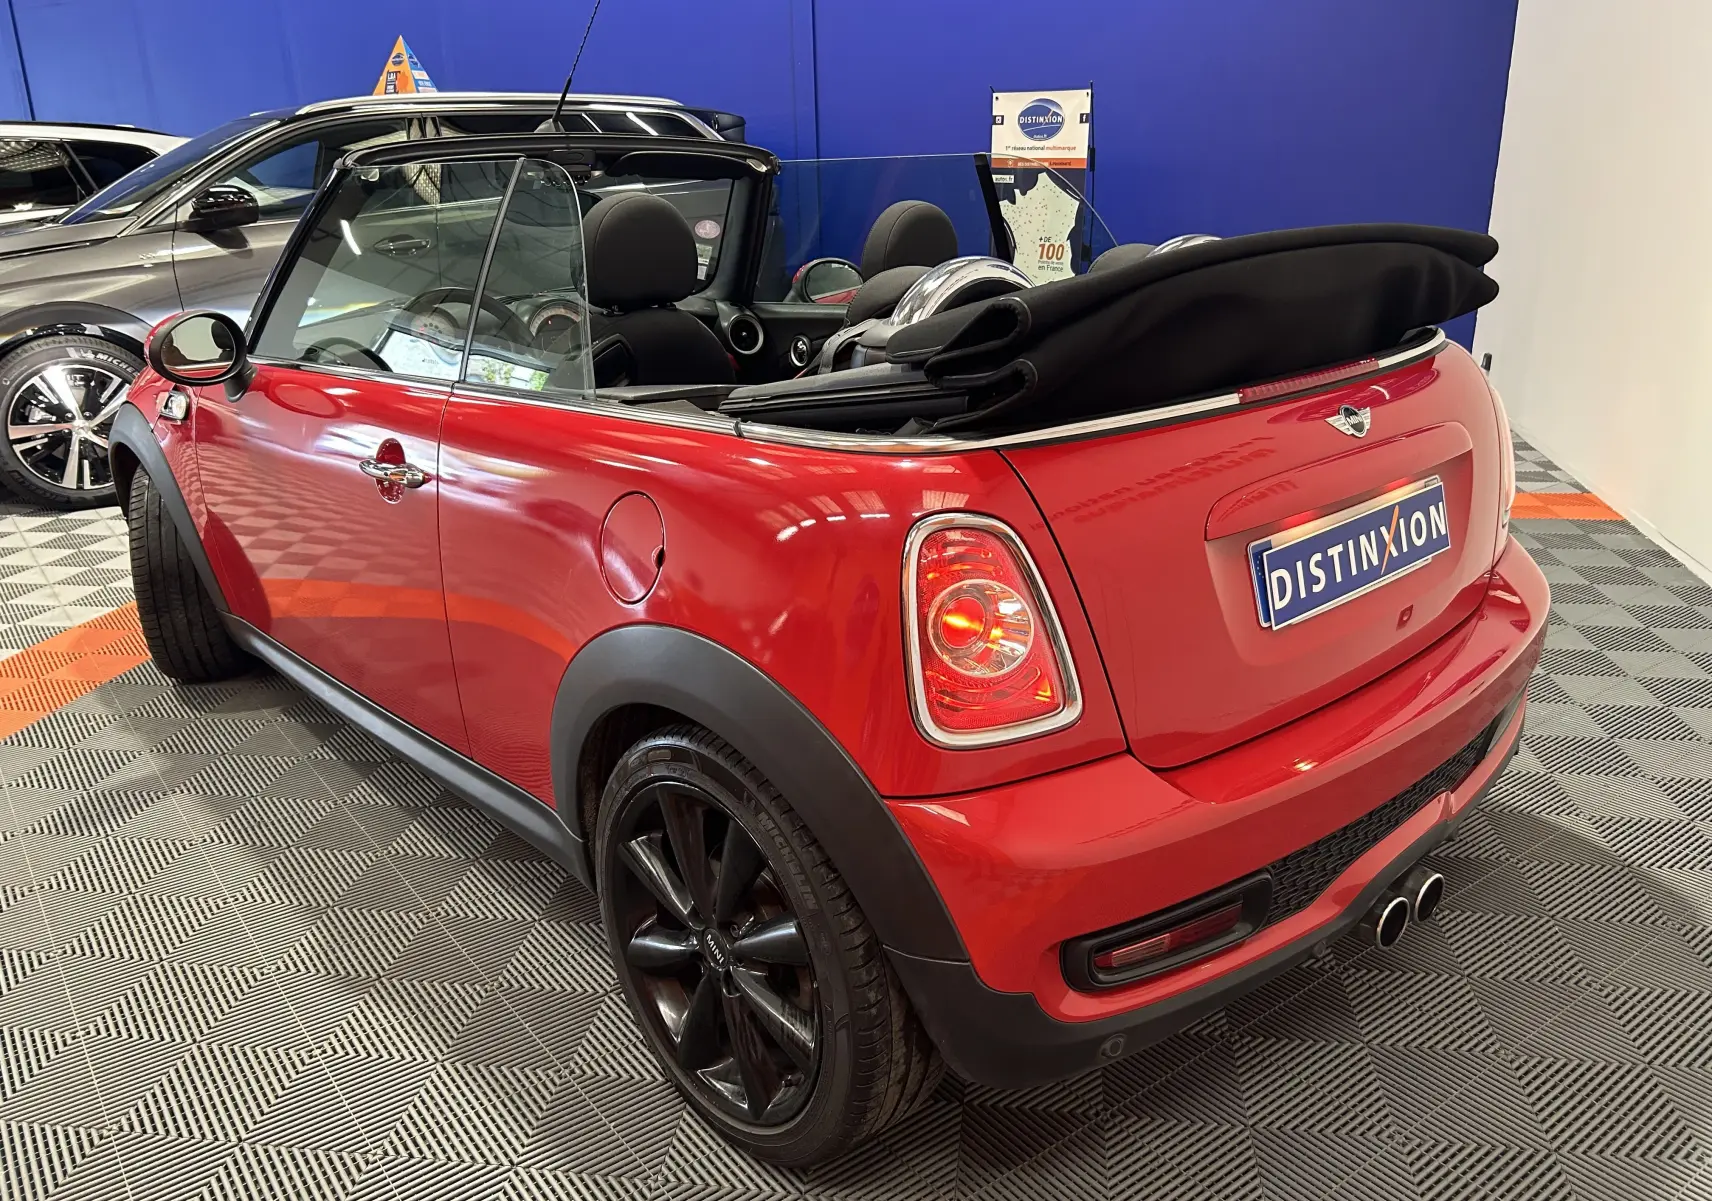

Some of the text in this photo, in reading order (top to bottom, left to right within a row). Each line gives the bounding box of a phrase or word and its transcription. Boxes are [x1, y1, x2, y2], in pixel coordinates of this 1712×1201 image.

[1020, 115, 1063, 124] DISTINXION
[1039, 243, 1064, 261] 100
[1345, 414, 1361, 425] MINI
[1269, 501, 1447, 611] DISTINXION
[756, 811, 819, 910] MICHELIN
[706, 933, 725, 964] MINI
